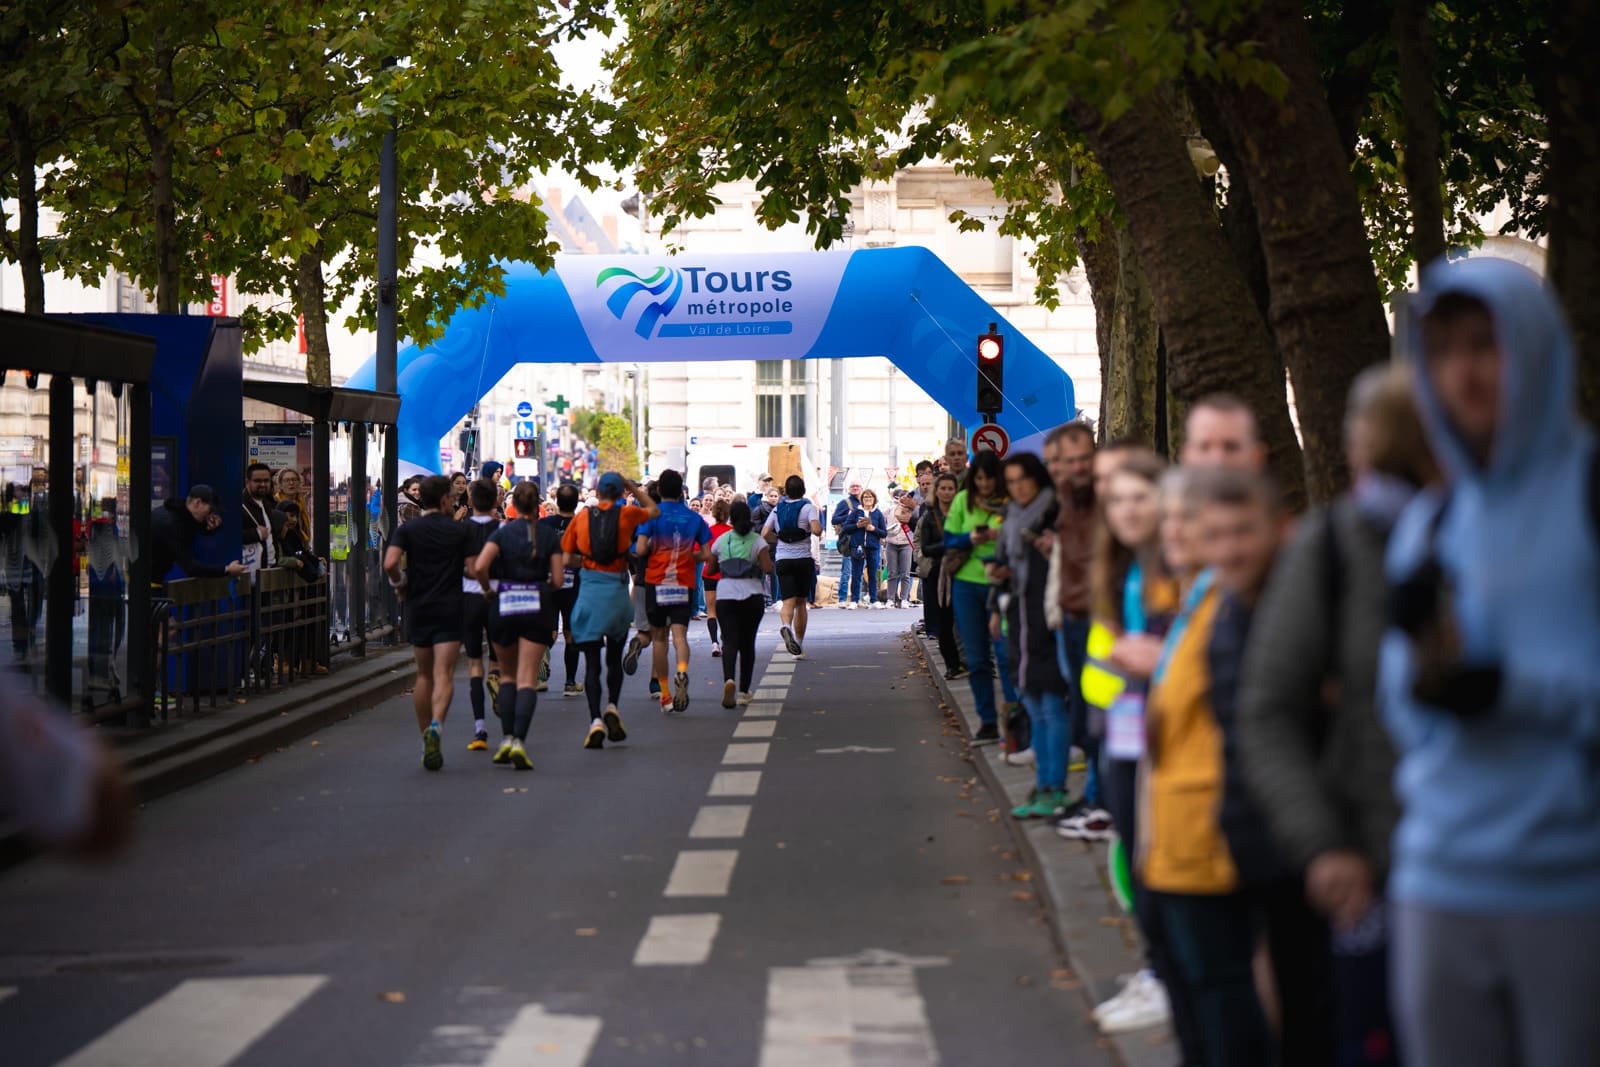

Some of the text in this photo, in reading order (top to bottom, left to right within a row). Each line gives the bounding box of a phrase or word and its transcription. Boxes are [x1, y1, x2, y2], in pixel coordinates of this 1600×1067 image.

[680, 267, 793, 293] Tours
[687, 298, 793, 318] métropole
[689, 323, 770, 336] Val de Loire
